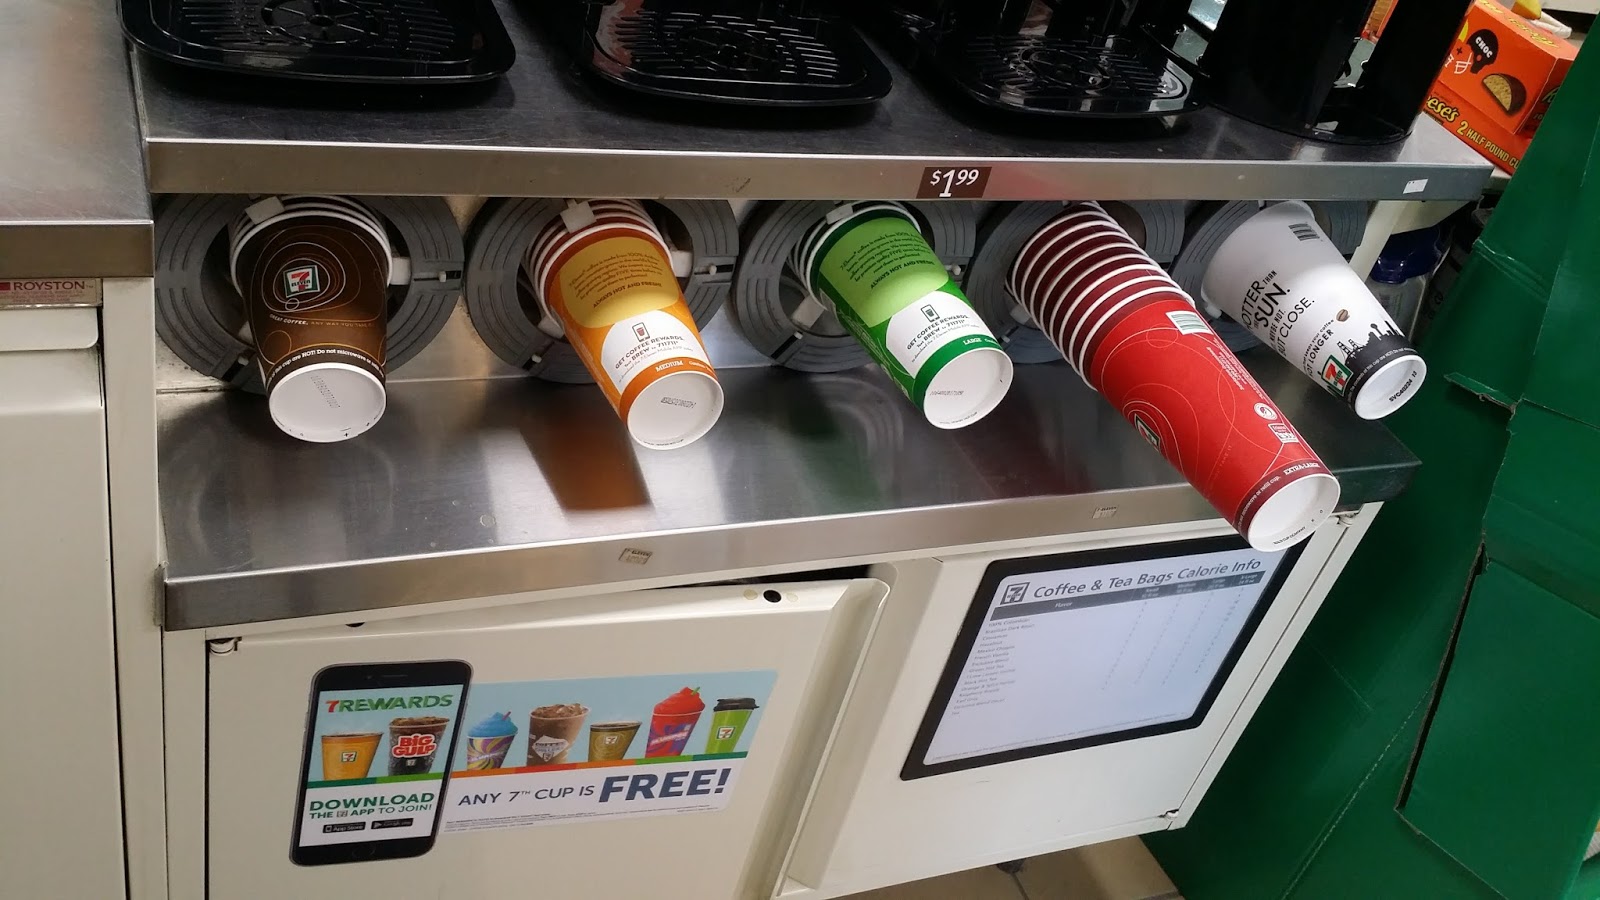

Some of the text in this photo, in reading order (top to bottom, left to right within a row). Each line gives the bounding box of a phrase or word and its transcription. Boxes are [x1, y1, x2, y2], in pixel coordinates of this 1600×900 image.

[1475, 36, 1493, 58] CHOC
[1427, 96, 1459, 122] ese's
[1457, 120, 1469, 135] 2
[1466, 128, 1486, 145] HALF
[1484, 141, 1510, 162] POUND
[870, 271, 890, 290] ALWAYS
[889, 265, 903, 274] HOT
[903, 260, 916, 268] AND
[1262, 269, 1278, 285] THAN
[13, 281, 85, 291] ROYSTON
[593, 290, 613, 308] ALWAYS
[612, 285, 626, 294] HOT
[627, 281, 641, 289] AND
[1254, 282, 1291, 328] SUN.
[1280, 297, 1315, 338] CLOSE.
[1319, 319, 1335, 333] coffee
[906, 337, 917, 350] GET
[916, 322, 940, 339] COFFEE
[923, 327, 940, 342] BREW
[962, 337, 982, 346] LARGE
[615, 356, 626, 370] GET
[625, 340, 650, 359] COFFEE
[631, 346, 650, 361] BREW
[1309, 329, 1334, 363] LONGER
[655, 360, 684, 373] MEDIUM
[1283, 462, 1321, 476] EXTRA-LARGE
[1033, 558, 1262, 598] Coffee & Tea Bags Calorie Info
[325, 694, 454, 713] 7REWARDS
[393, 744, 436, 758] GULP
[458, 792, 502, 806] ANY
[534, 786, 574, 801] CUP
[579, 785, 595, 797] IS
[598, 768, 732, 803] FREE!
[309, 792, 435, 812] DOWNLOAD
[309, 803, 432, 820] THE APP TO JOIN!
